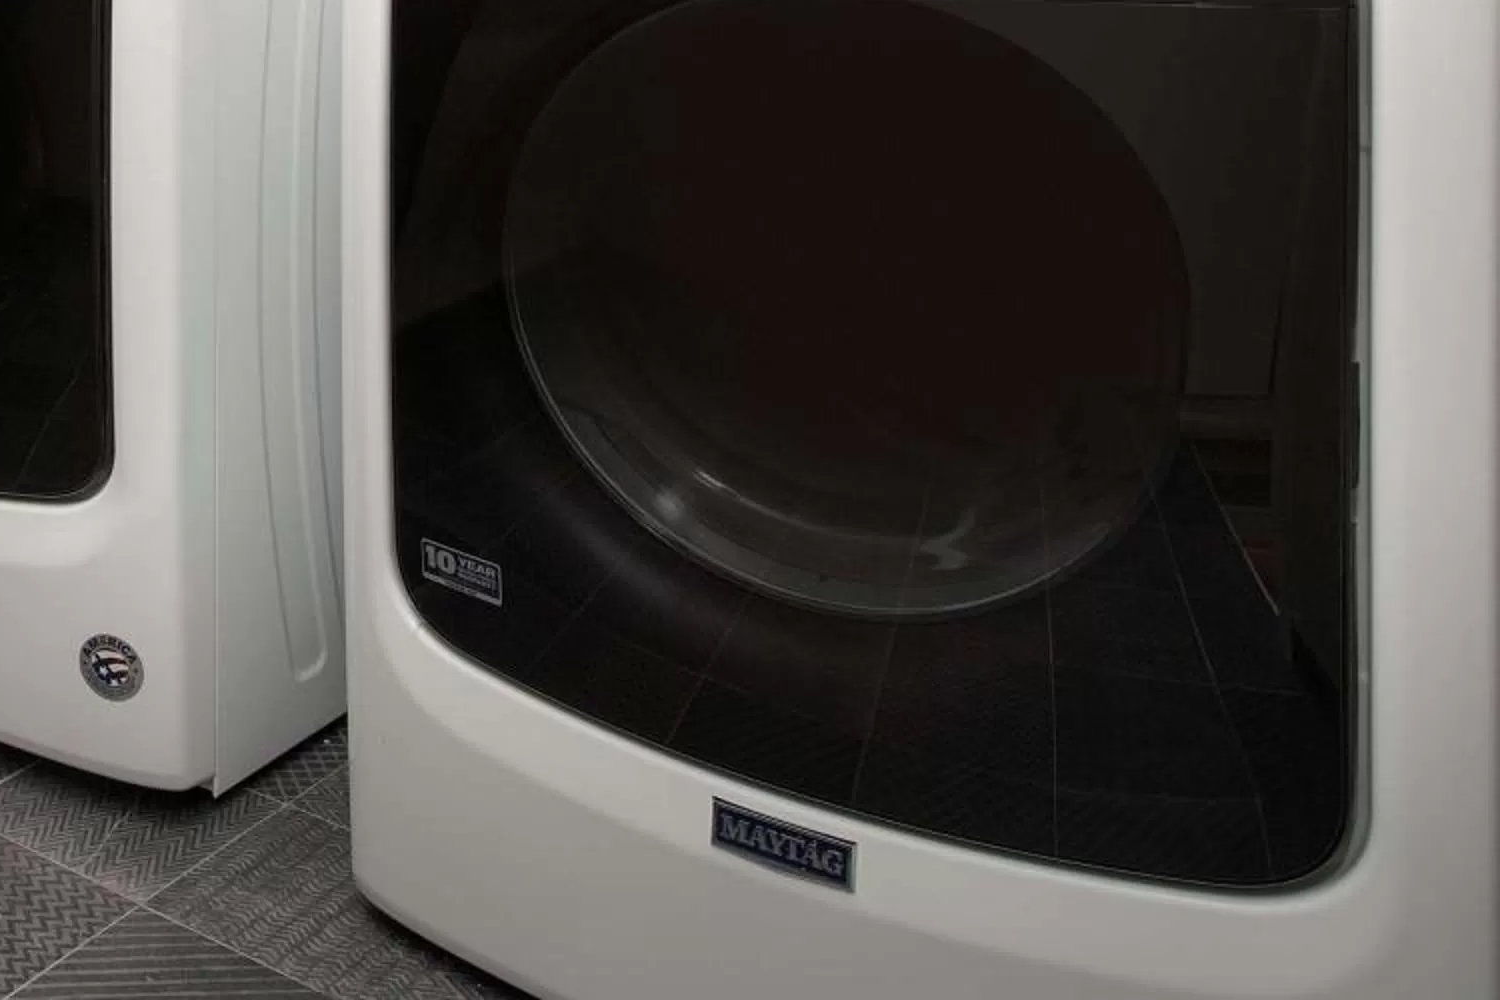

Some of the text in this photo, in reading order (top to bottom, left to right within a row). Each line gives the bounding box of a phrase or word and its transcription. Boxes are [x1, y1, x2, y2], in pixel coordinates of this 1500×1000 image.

[425, 545, 496, 578] 10 YEAR
[82, 634, 138, 665] AMERICA
[718, 811, 845, 877] MAYTAG
